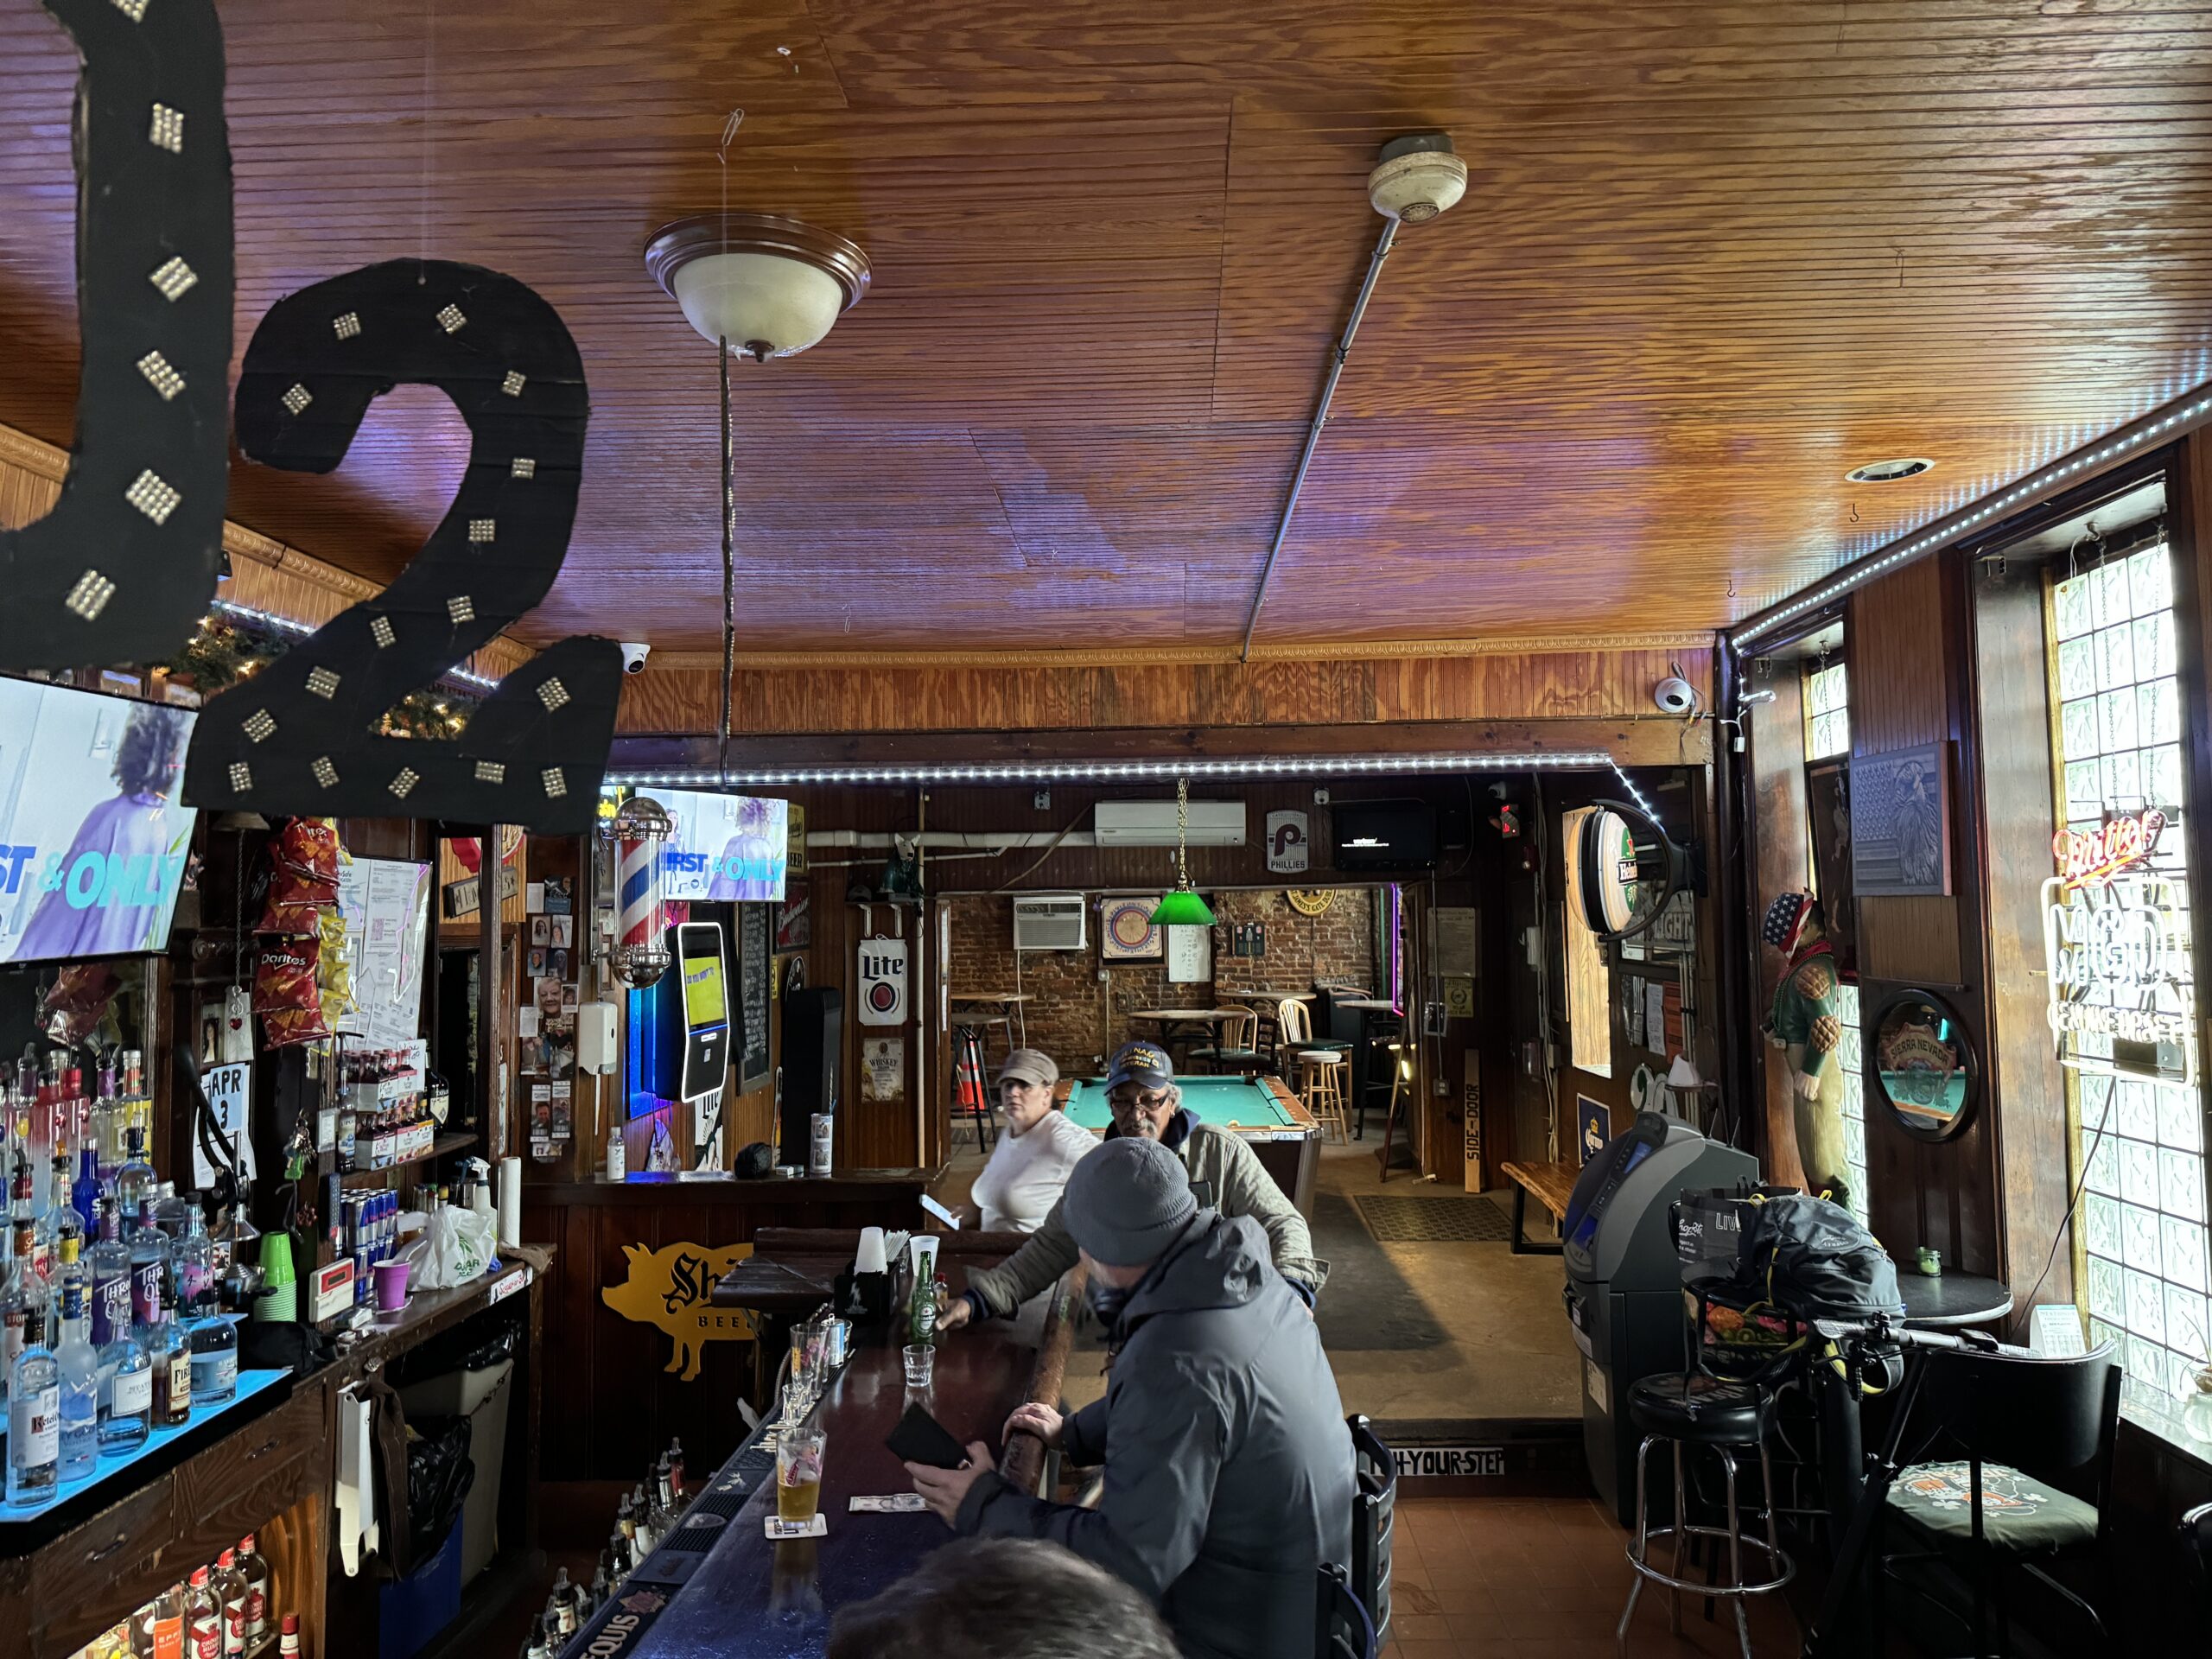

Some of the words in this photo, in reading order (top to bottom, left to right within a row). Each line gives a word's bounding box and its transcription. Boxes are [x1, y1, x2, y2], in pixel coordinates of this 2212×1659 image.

[725, 856, 785, 880] ONLY
[1270, 861, 1306, 869] PHILLIES
[65, 850, 184, 910] ONLY
[261, 953, 306, 967] Doritos
[862, 956, 905, 981] Lite
[869, 1058, 898, 1067] WHISKEY
[1891, 1039, 1916, 1058] SIERRA
[1917, 1039, 1949, 1065] NEVADA
[212, 1069, 242, 1097] APR
[220, 1099, 228, 1129] 3
[1465, 1084, 1479, 1160] SIDE-DOOR
[1679, 1219, 1704, 1237] hopRite
[1715, 1212, 1741, 1231] LIV
